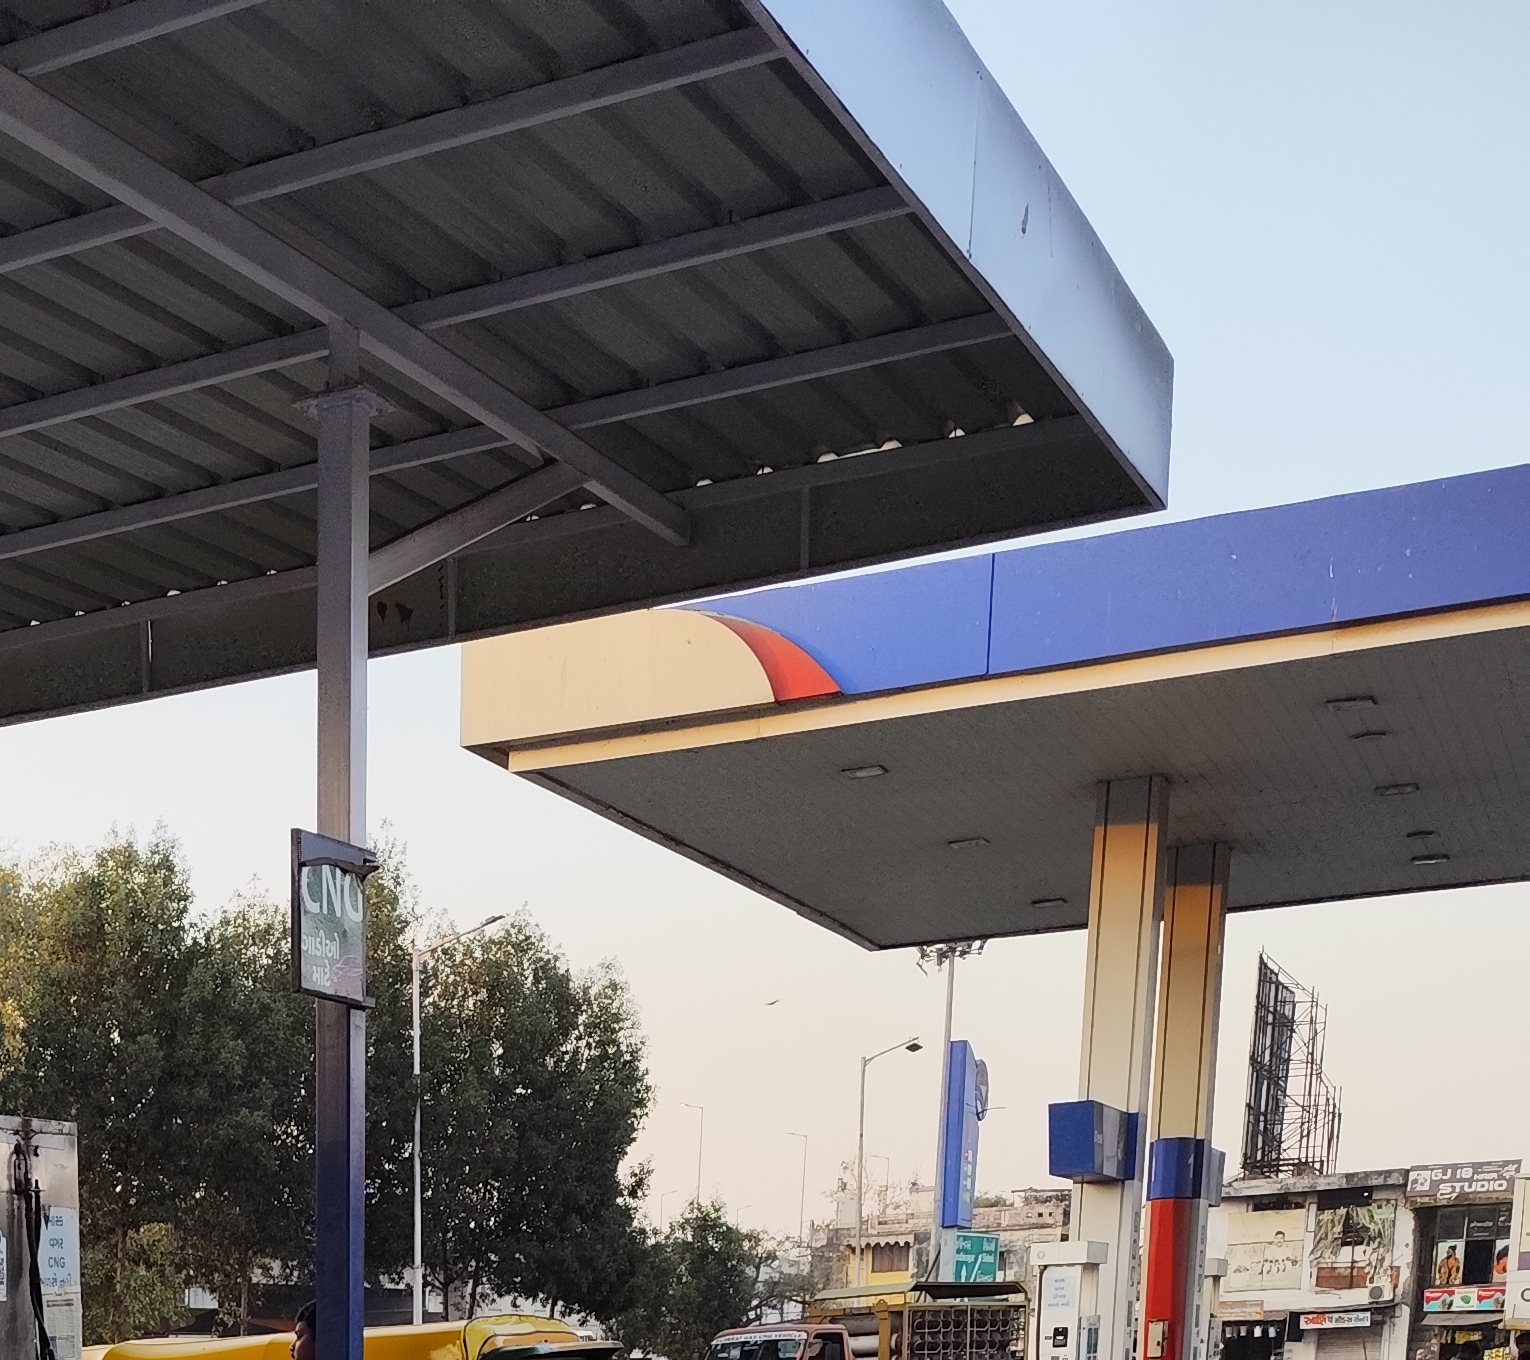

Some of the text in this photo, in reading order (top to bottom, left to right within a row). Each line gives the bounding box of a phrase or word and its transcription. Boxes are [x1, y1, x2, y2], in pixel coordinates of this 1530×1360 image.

[1431, 1168, 1452, 1181] GJ
[1456, 1167, 1473, 1179] 18
[1438, 1179, 1508, 1195] STUDIO
[48, 1256, 66, 1269] CNG
